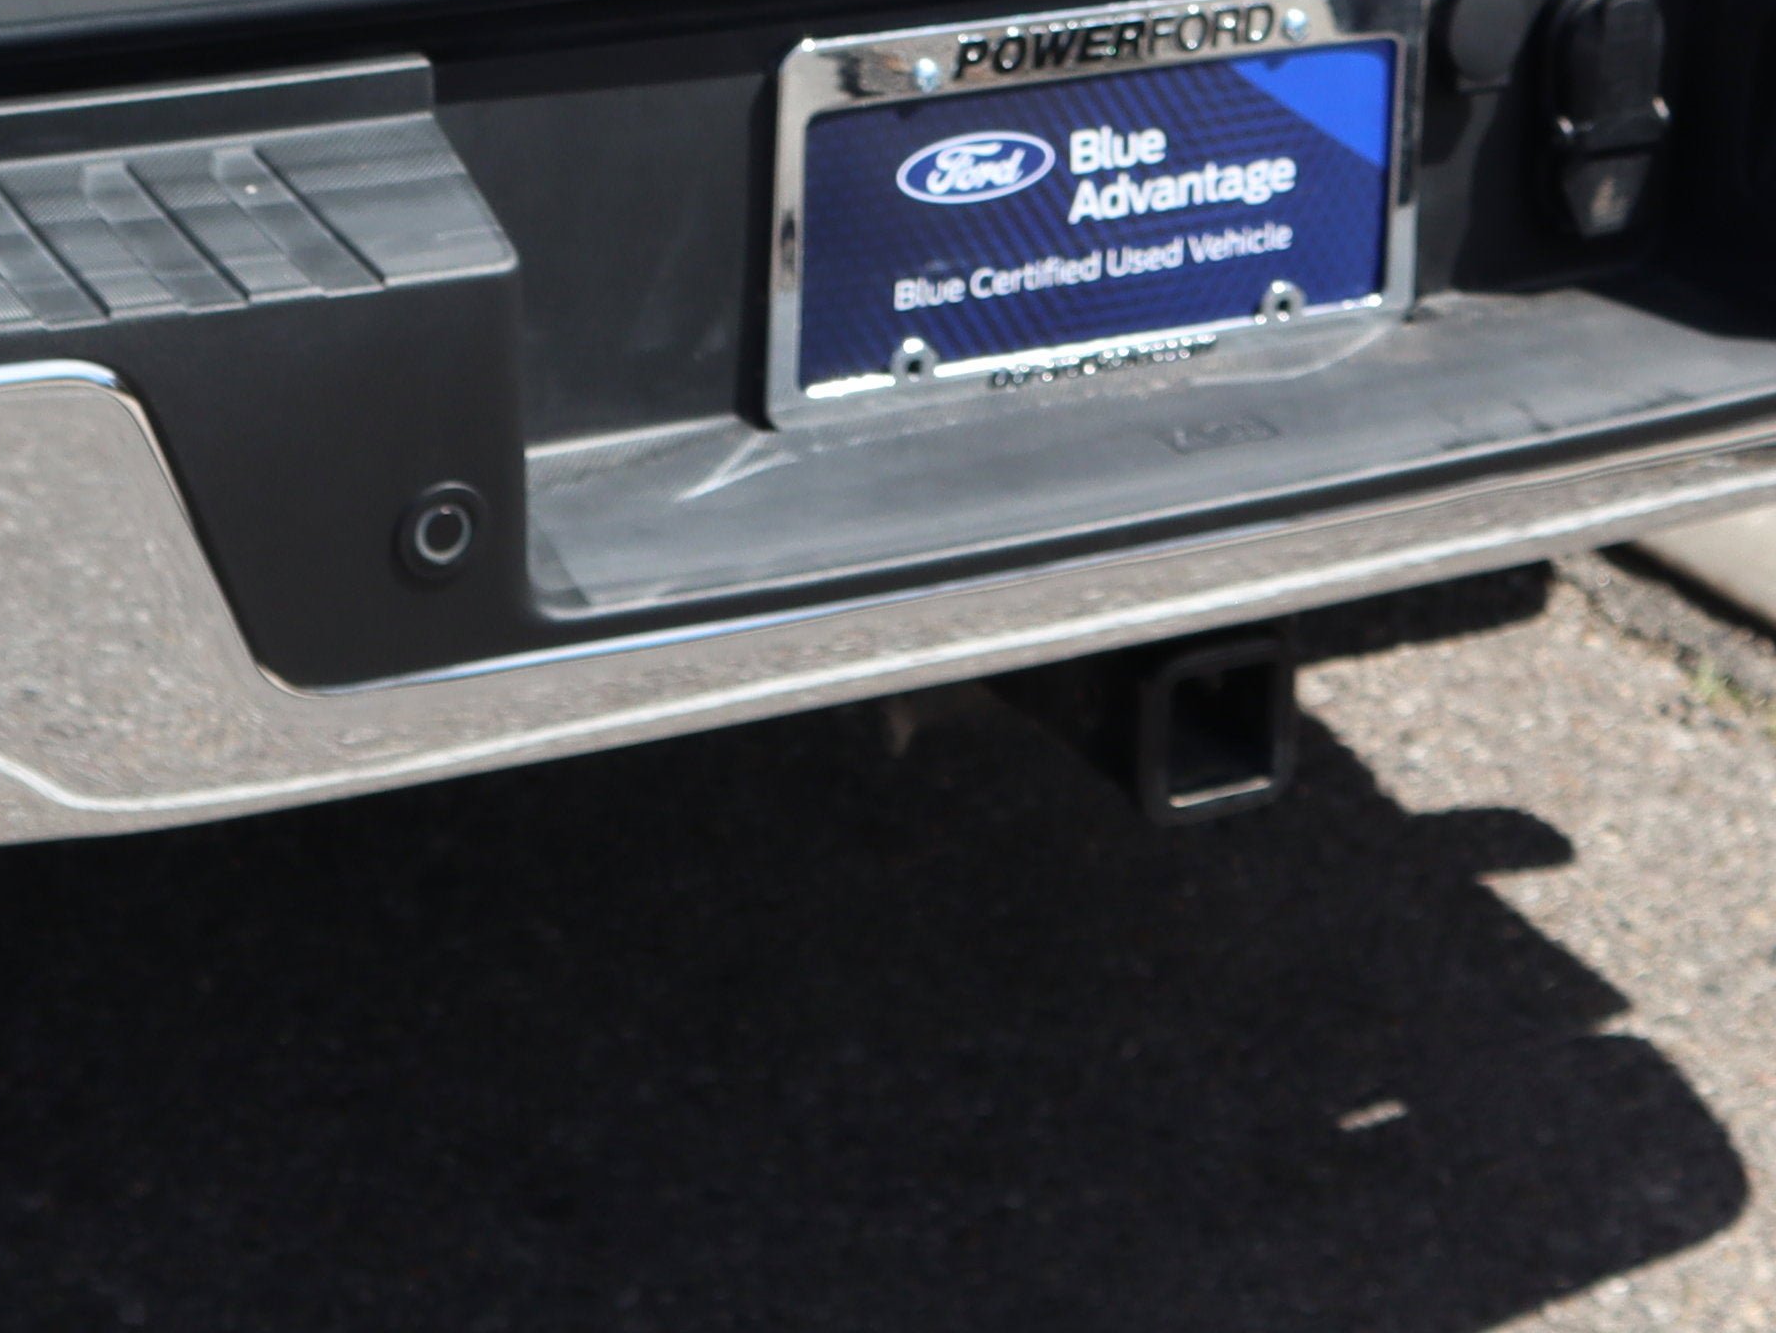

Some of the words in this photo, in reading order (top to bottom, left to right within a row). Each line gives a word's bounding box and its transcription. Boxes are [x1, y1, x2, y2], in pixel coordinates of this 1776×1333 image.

[925, 142, 1026, 196] Ford
[1069, 124, 1167, 175] Blue
[1067, 156, 1298, 225] Advantage
[893, 276, 966, 312] Blue
[969, 250, 1101, 300] Certified
[1105, 236, 1184, 277] Used
[1186, 220, 1294, 265] Vehicle
